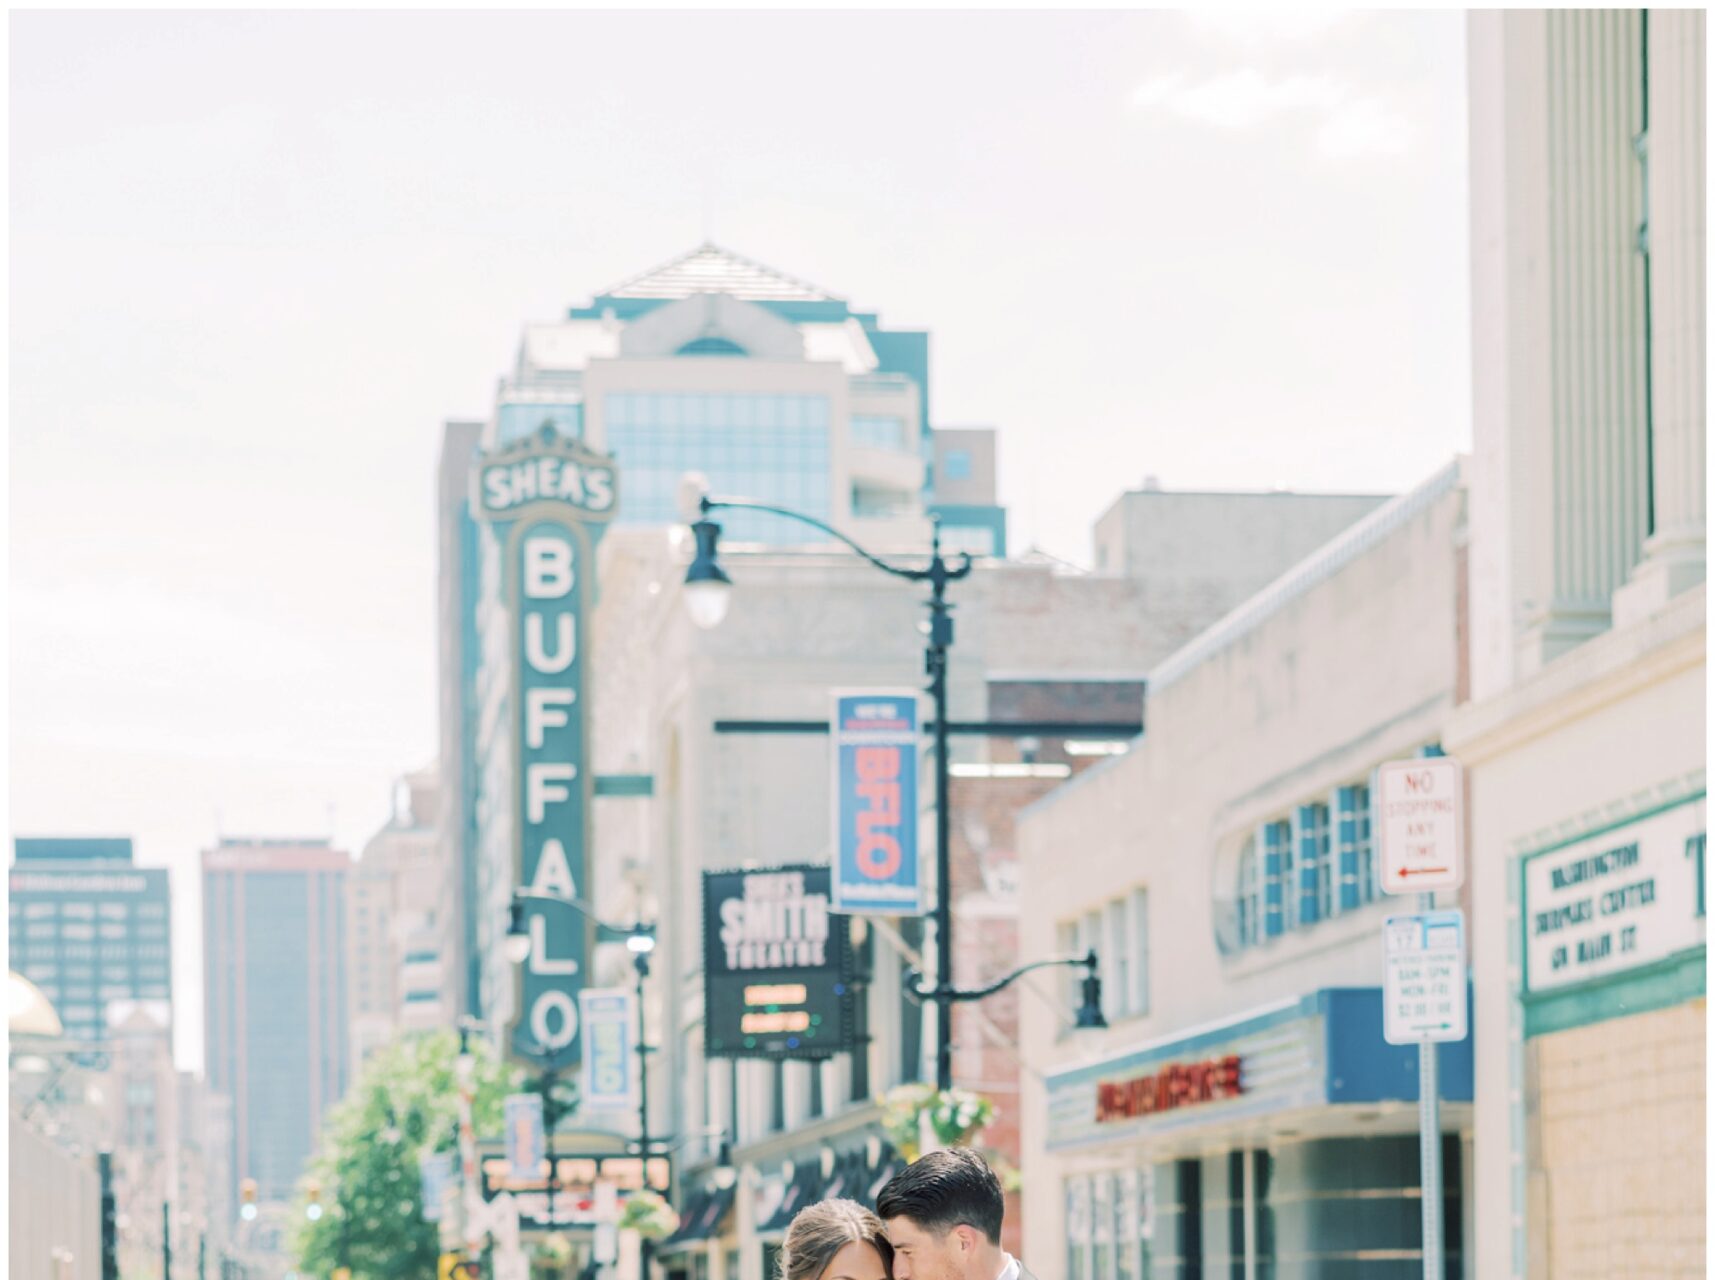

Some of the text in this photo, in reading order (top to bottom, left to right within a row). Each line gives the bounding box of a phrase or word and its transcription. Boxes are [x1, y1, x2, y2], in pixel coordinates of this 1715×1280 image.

[485, 457, 613, 510] SHEA'S
[525, 537, 579, 1048] BUFFALO
[1404, 771, 1434, 794] NO
[719, 894, 829, 946] SMITH
